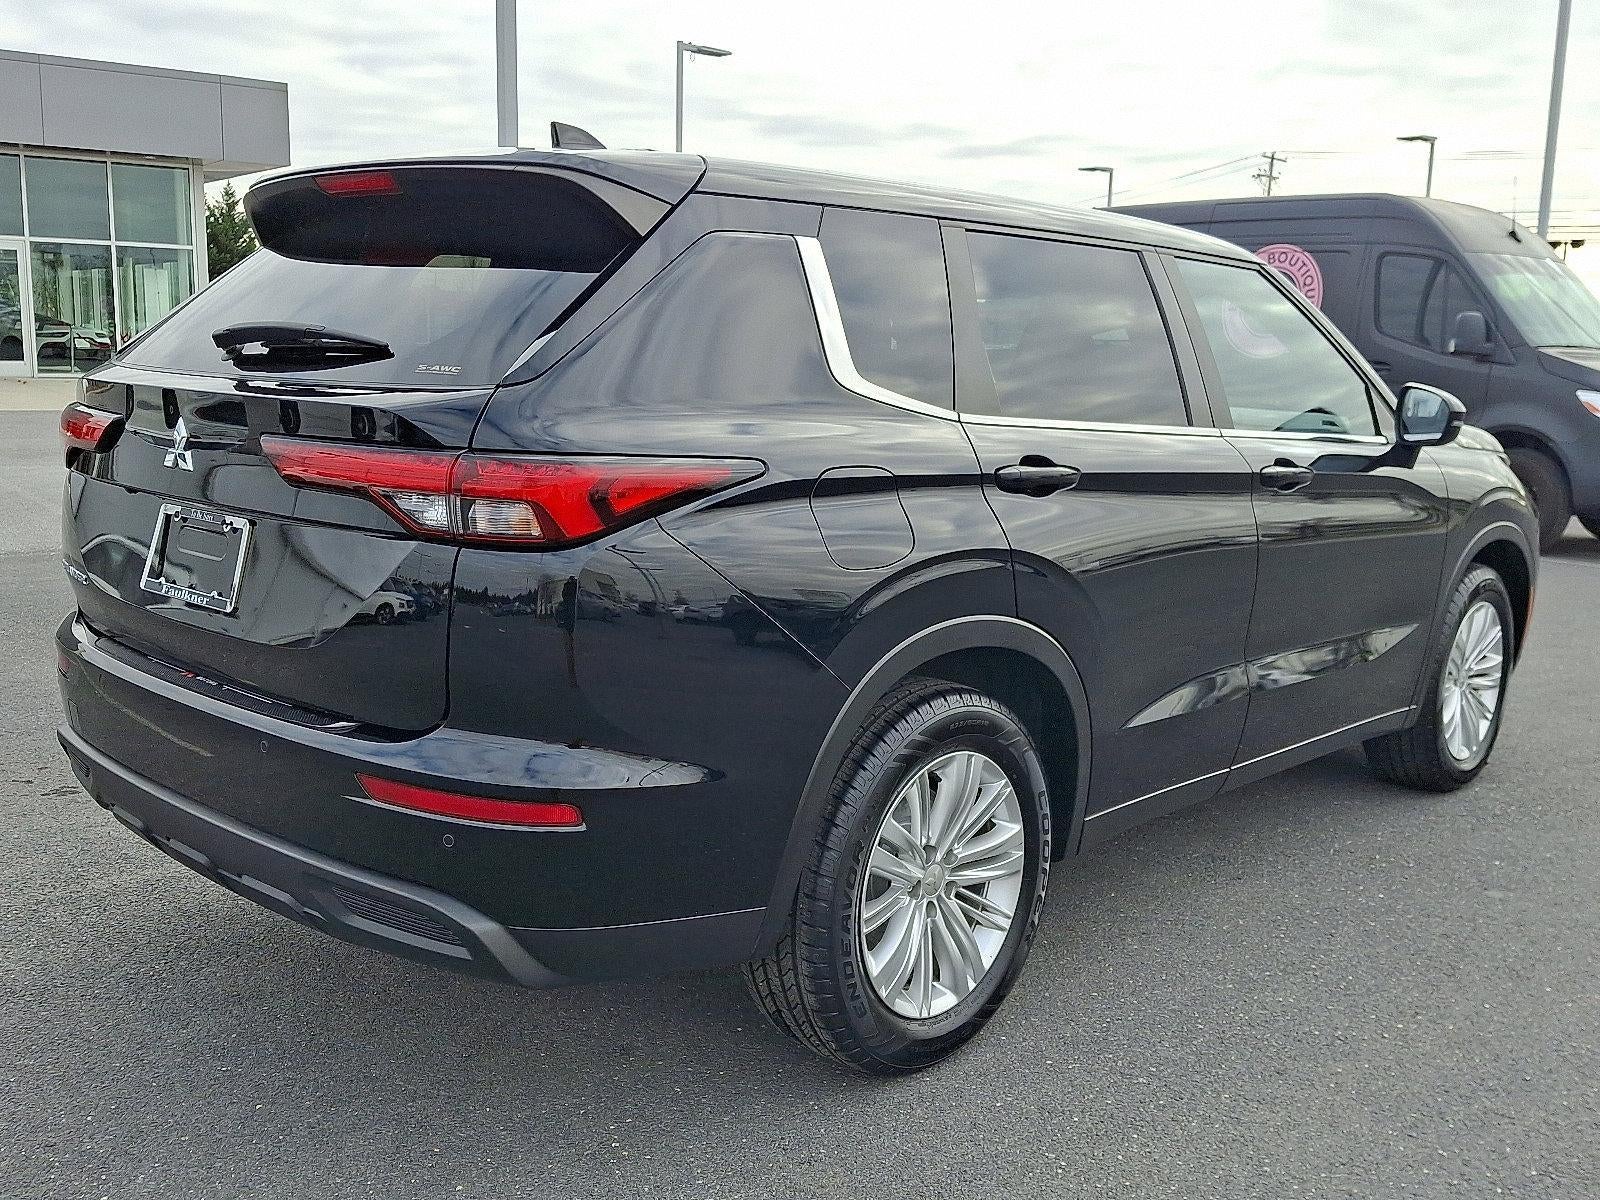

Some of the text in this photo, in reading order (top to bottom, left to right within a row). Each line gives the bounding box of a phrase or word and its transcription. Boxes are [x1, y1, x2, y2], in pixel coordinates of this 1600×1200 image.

[1267, 251, 1315, 299] BOUTIQU
[416, 364, 462, 373] S-AWC
[161, 584, 210, 605] Faulkner
